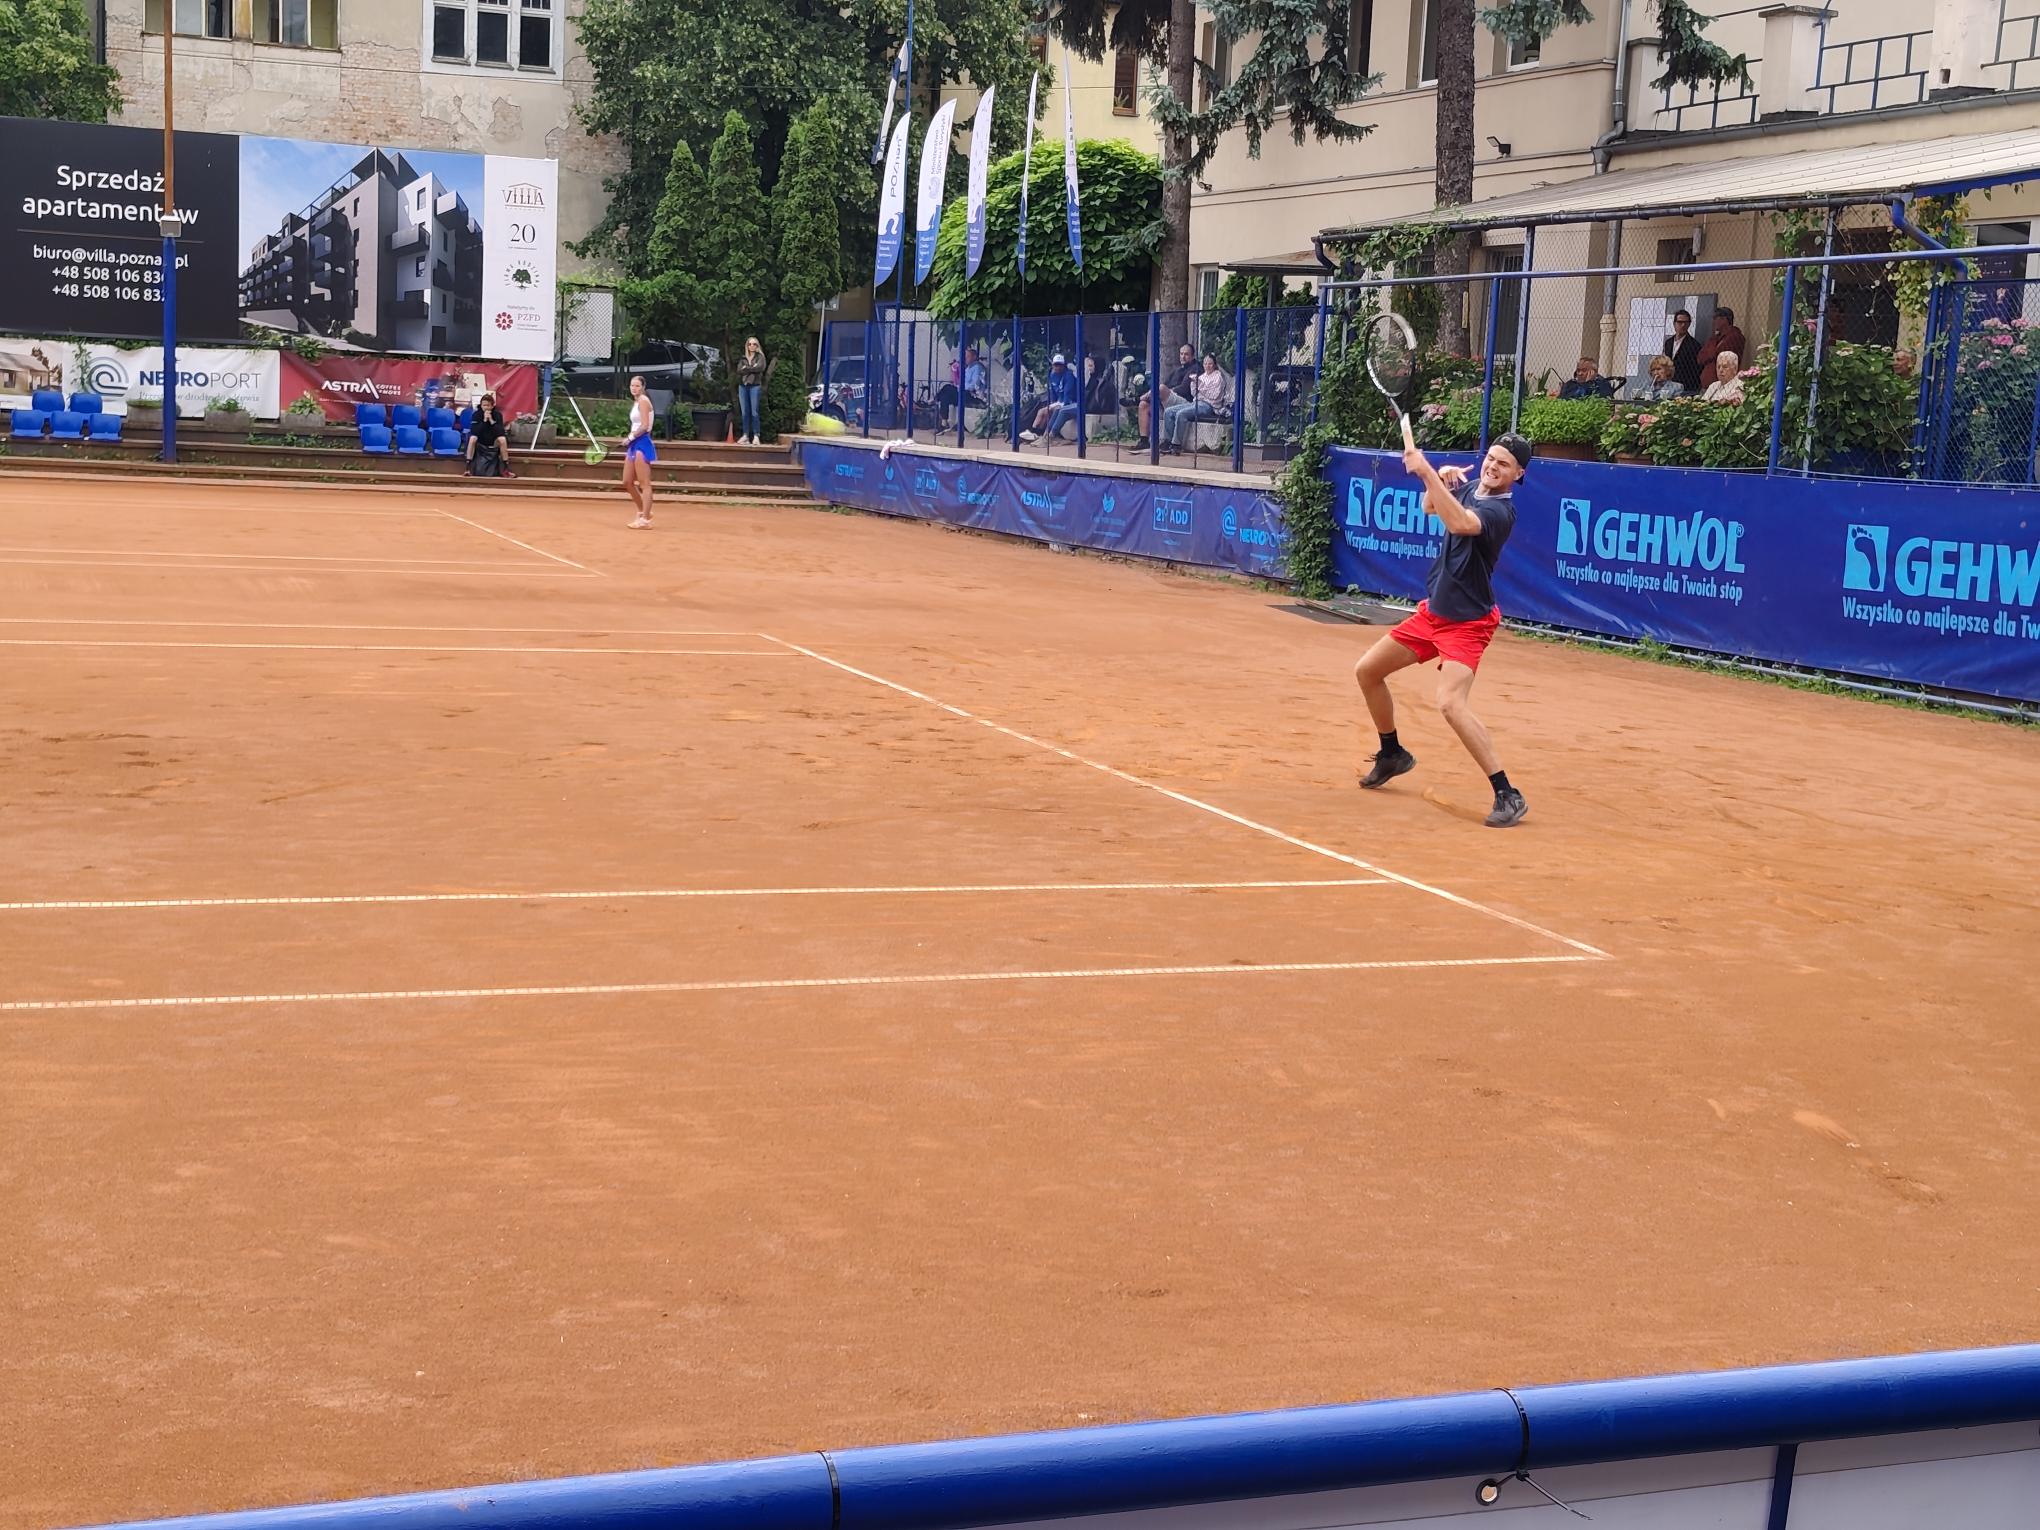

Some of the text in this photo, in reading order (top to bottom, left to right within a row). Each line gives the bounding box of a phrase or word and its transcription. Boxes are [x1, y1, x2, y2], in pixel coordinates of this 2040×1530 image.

[57, 165, 165, 192] Sprzedaż
[502, 188, 544, 205] VILLA
[510, 223, 536, 243] 20
[33, 244, 188, 268] biuro@villa.poznapl
[52, 265, 79, 279] +48
[83, 268, 109, 281] 508
[114, 269, 140, 283] 106
[52, 283, 164, 302] +48 508 106 83
[1170, 508, 1188, 525] ADD
[1240, 528, 1283, 548] NEUROPO
[1345, 530, 1378, 553] Wszystko
[1380, 541, 1388, 552] co
[1390, 537, 1423, 559] najlepsze
[1425, 540, 1437, 558] dla
[1556, 559, 1743, 607] Wszystko co najlepsze dla Twoich stóp
[1842, 596, 1903, 627] Wszystko
[1906, 608, 1921, 626] co
[1924, 604, 1989, 638] najlepsze
[1993, 610, 2016, 638] dla
